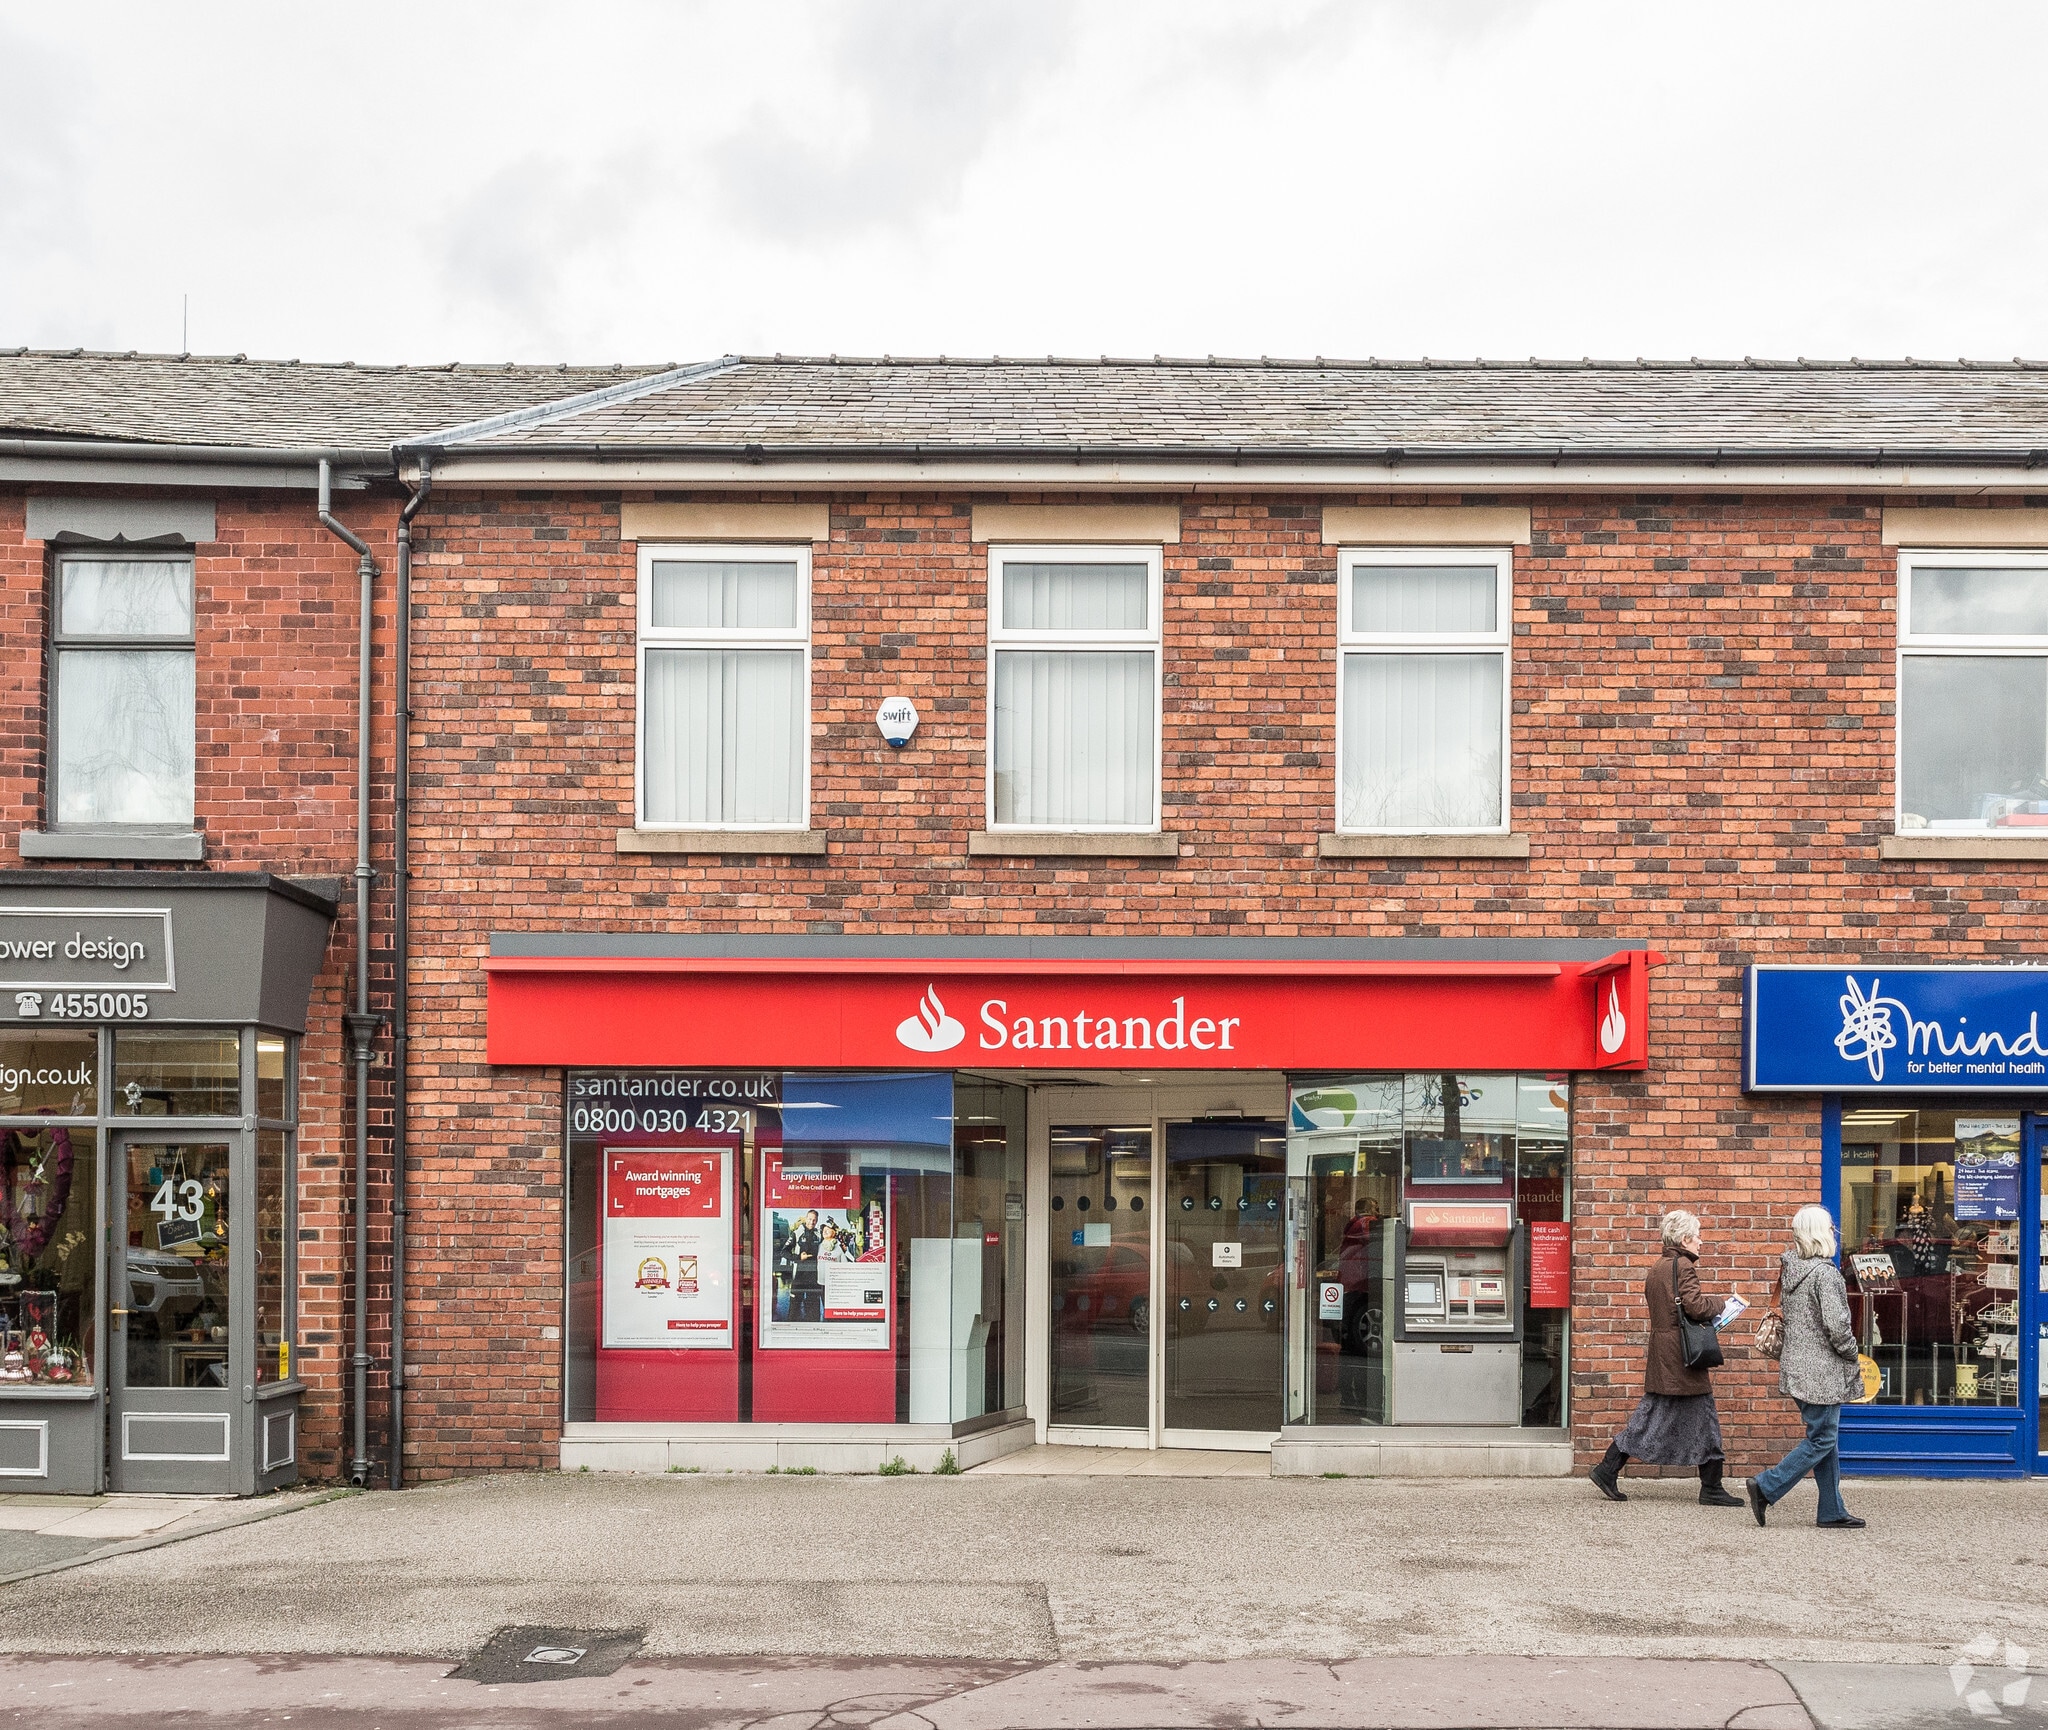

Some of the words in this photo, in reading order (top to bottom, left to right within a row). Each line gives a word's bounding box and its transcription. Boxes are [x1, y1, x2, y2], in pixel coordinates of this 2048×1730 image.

[882, 707, 911, 722] swift
[0, 940, 56, 959] ower
[64, 931, 145, 969] design
[50, 993, 148, 1018] 455005
[979, 996, 1240, 1050] Santander
[0, 1061, 92, 1092] ign.co.uk
[1907, 1061, 1925, 1074] for
[1928, 1061, 1963, 1074] better
[1966, 1062, 2005, 1074] mental
[2009, 1061, 2045, 1074] health
[574, 1074, 774, 1098] santander.co.uk
[574, 1108, 636, 1133] 0800
[643, 1109, 687, 1133] 030
[694, 1110, 751, 1133] 4321
[1853, 1150, 1879, 1159] health
[625, 1170, 659, 1181] Award
[660, 1171, 702, 1185] winning
[150, 1179, 205, 1222] 43
[635, 1185, 691, 1198] mortgages
[1518, 1189, 1562, 1203] ntande
[1442, 1212, 1496, 1224] Santander
